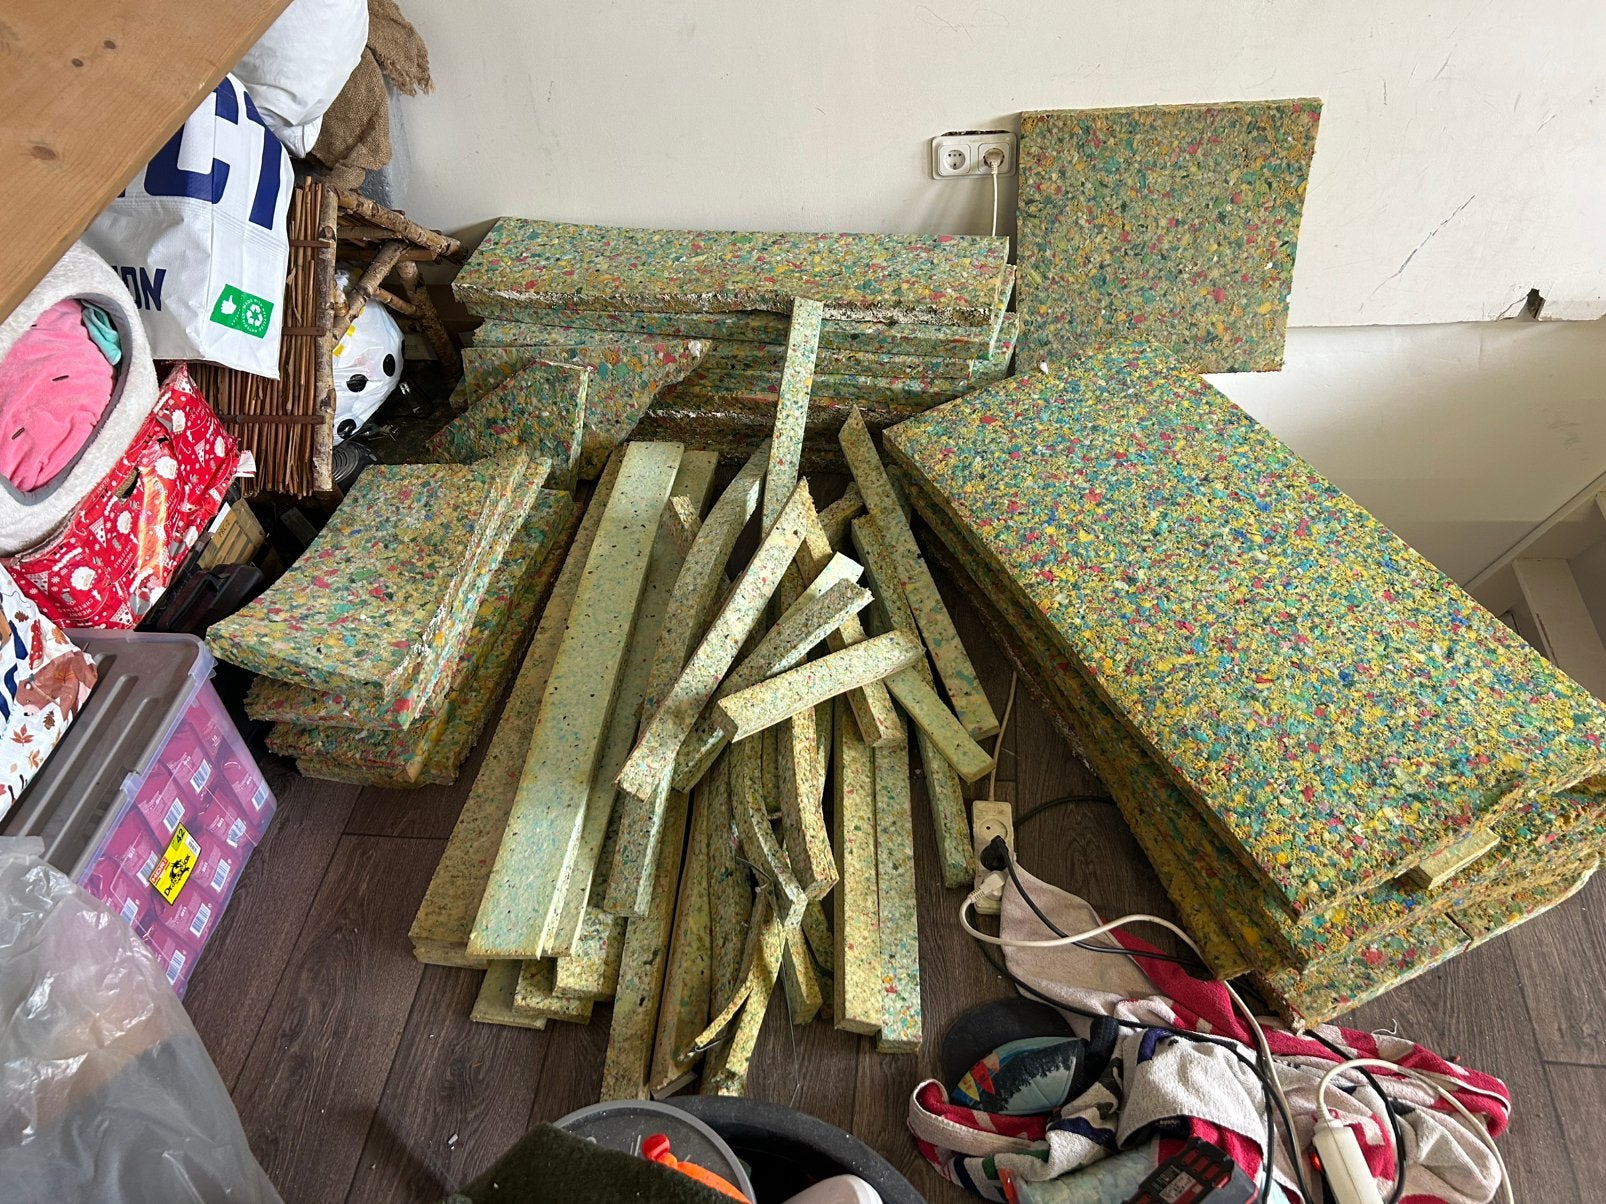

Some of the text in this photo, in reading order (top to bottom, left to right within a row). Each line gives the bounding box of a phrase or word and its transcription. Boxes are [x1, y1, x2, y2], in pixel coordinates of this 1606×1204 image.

[111, 266, 167, 311] ON
[57, 598, 94, 614] CHRISTMAS
[69, 608, 93, 618] MERRY
[176, 828, 186, 844] 42
